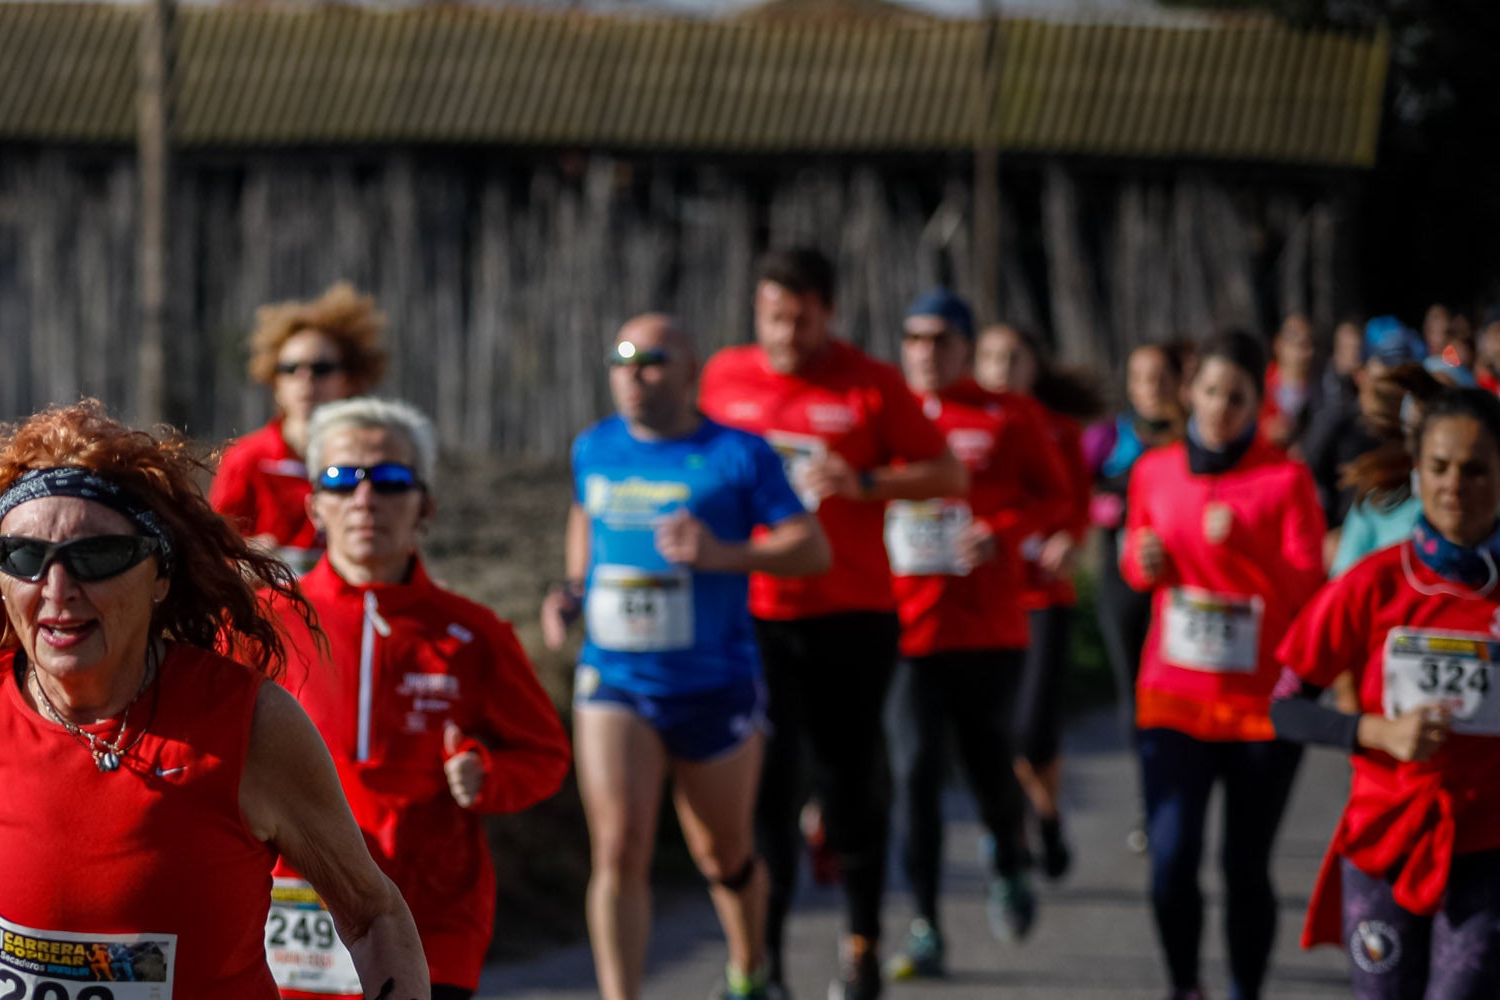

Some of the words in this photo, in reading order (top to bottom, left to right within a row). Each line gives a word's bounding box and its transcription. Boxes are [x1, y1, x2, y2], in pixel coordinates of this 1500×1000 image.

[1419, 658, 1488, 695] 324
[4, 931, 85, 956] CARRERA
[269, 914, 334, 950] 249
[4, 943, 84, 965] POPULAR
